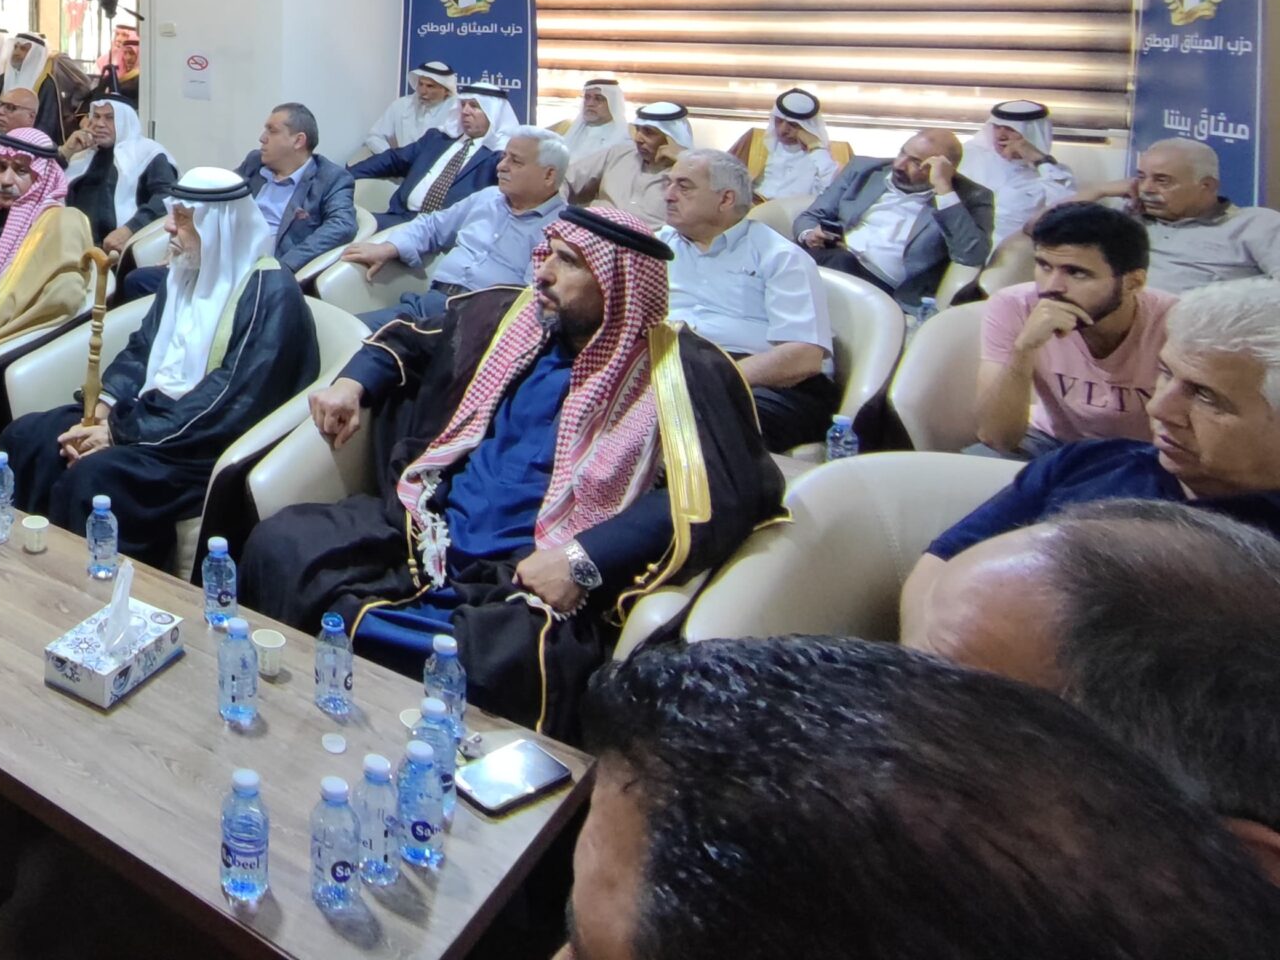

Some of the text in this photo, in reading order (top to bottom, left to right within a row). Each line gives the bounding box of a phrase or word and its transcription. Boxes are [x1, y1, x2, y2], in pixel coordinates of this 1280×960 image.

[417, 21, 523, 38] حزب الميثاق الوطني
[1180, 33, 1224, 54] الميثاق
[1227, 35, 1252, 56] حزب
[1194, 107, 1250, 144] ميثاق
